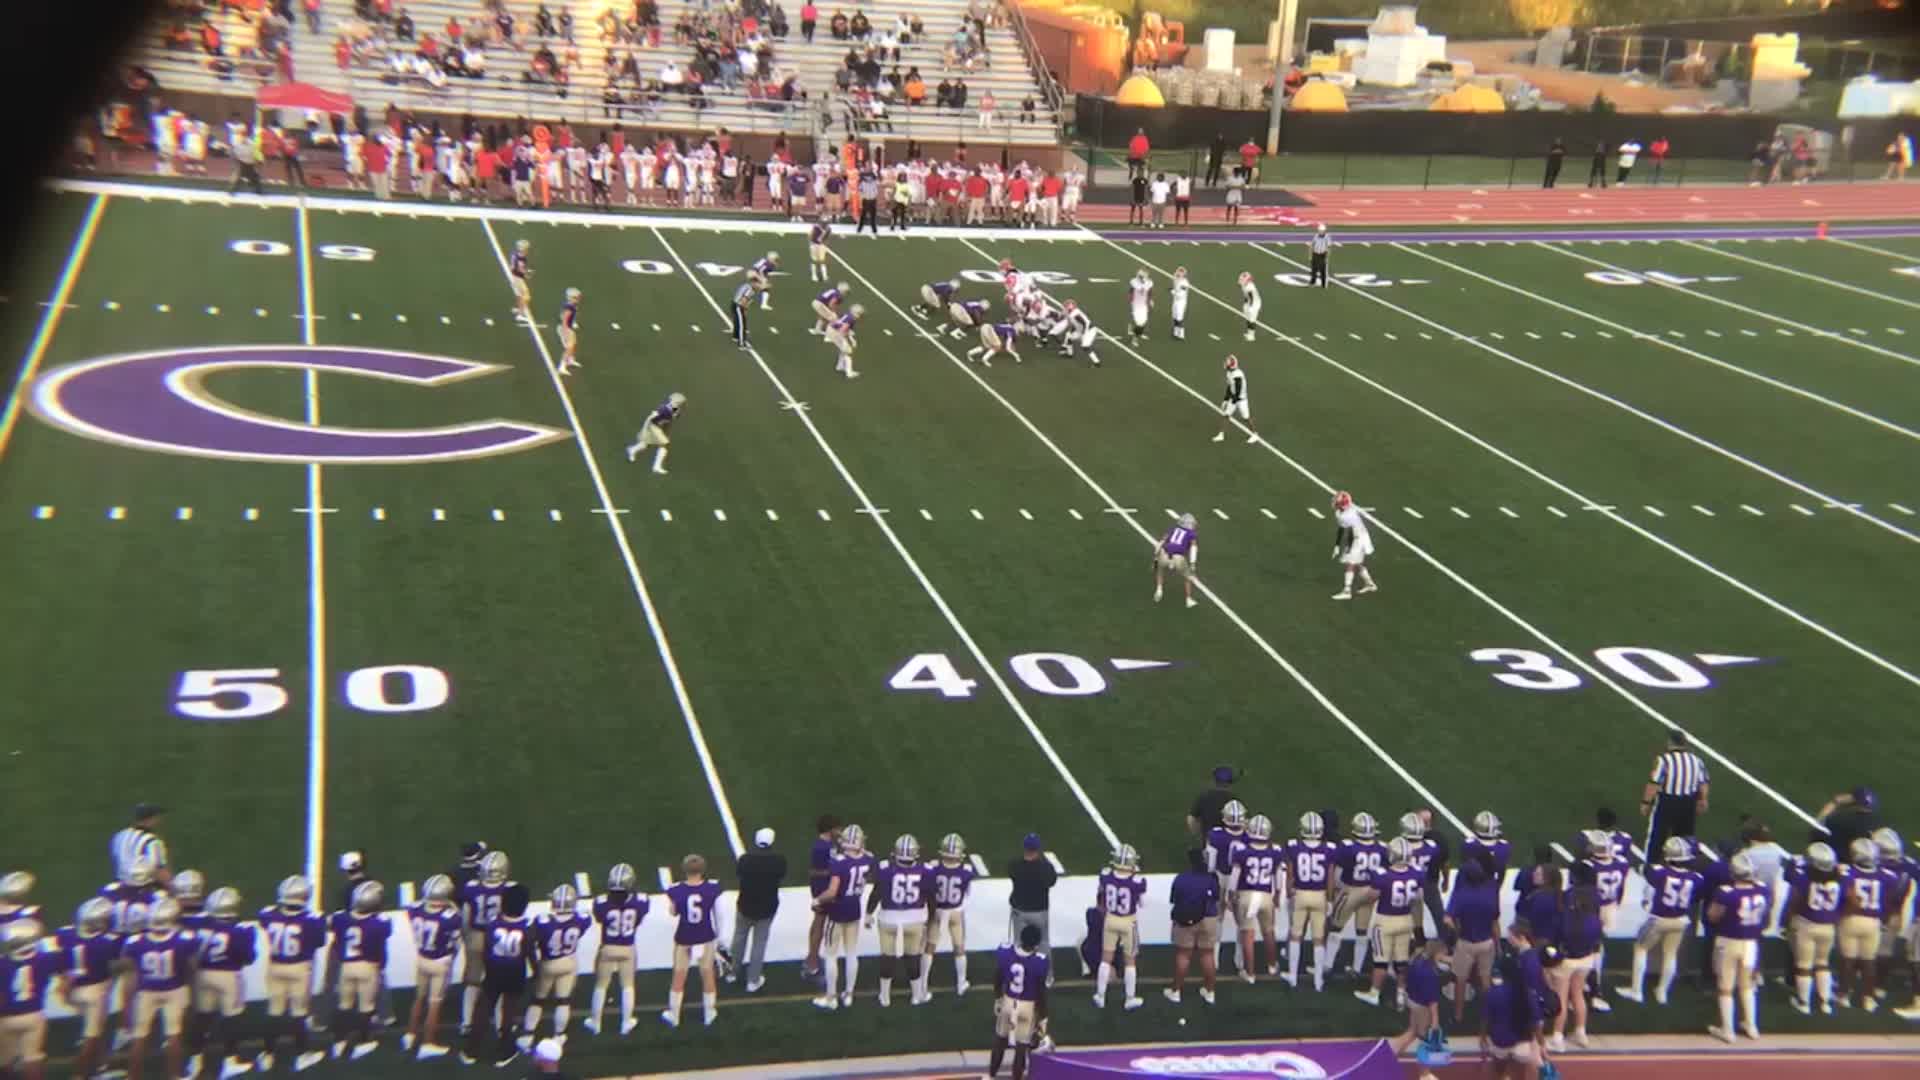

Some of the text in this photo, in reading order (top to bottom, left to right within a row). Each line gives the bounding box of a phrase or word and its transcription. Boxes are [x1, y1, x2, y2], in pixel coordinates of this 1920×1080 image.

[845, 864, 870, 897] 15
[1245, 856, 1274, 885] 32
[1296, 852, 1326, 882] 85
[891, 873, 921, 904] 65
[935, 874, 963, 905] 36
[1104, 882, 1132, 915] 83
[605, 908, 638, 938] 38
[687, 894, 704, 924] 6
[268, 921, 303, 957] 76
[344, 926, 363, 958] 2
[1009, 962, 1026, 994] 3
